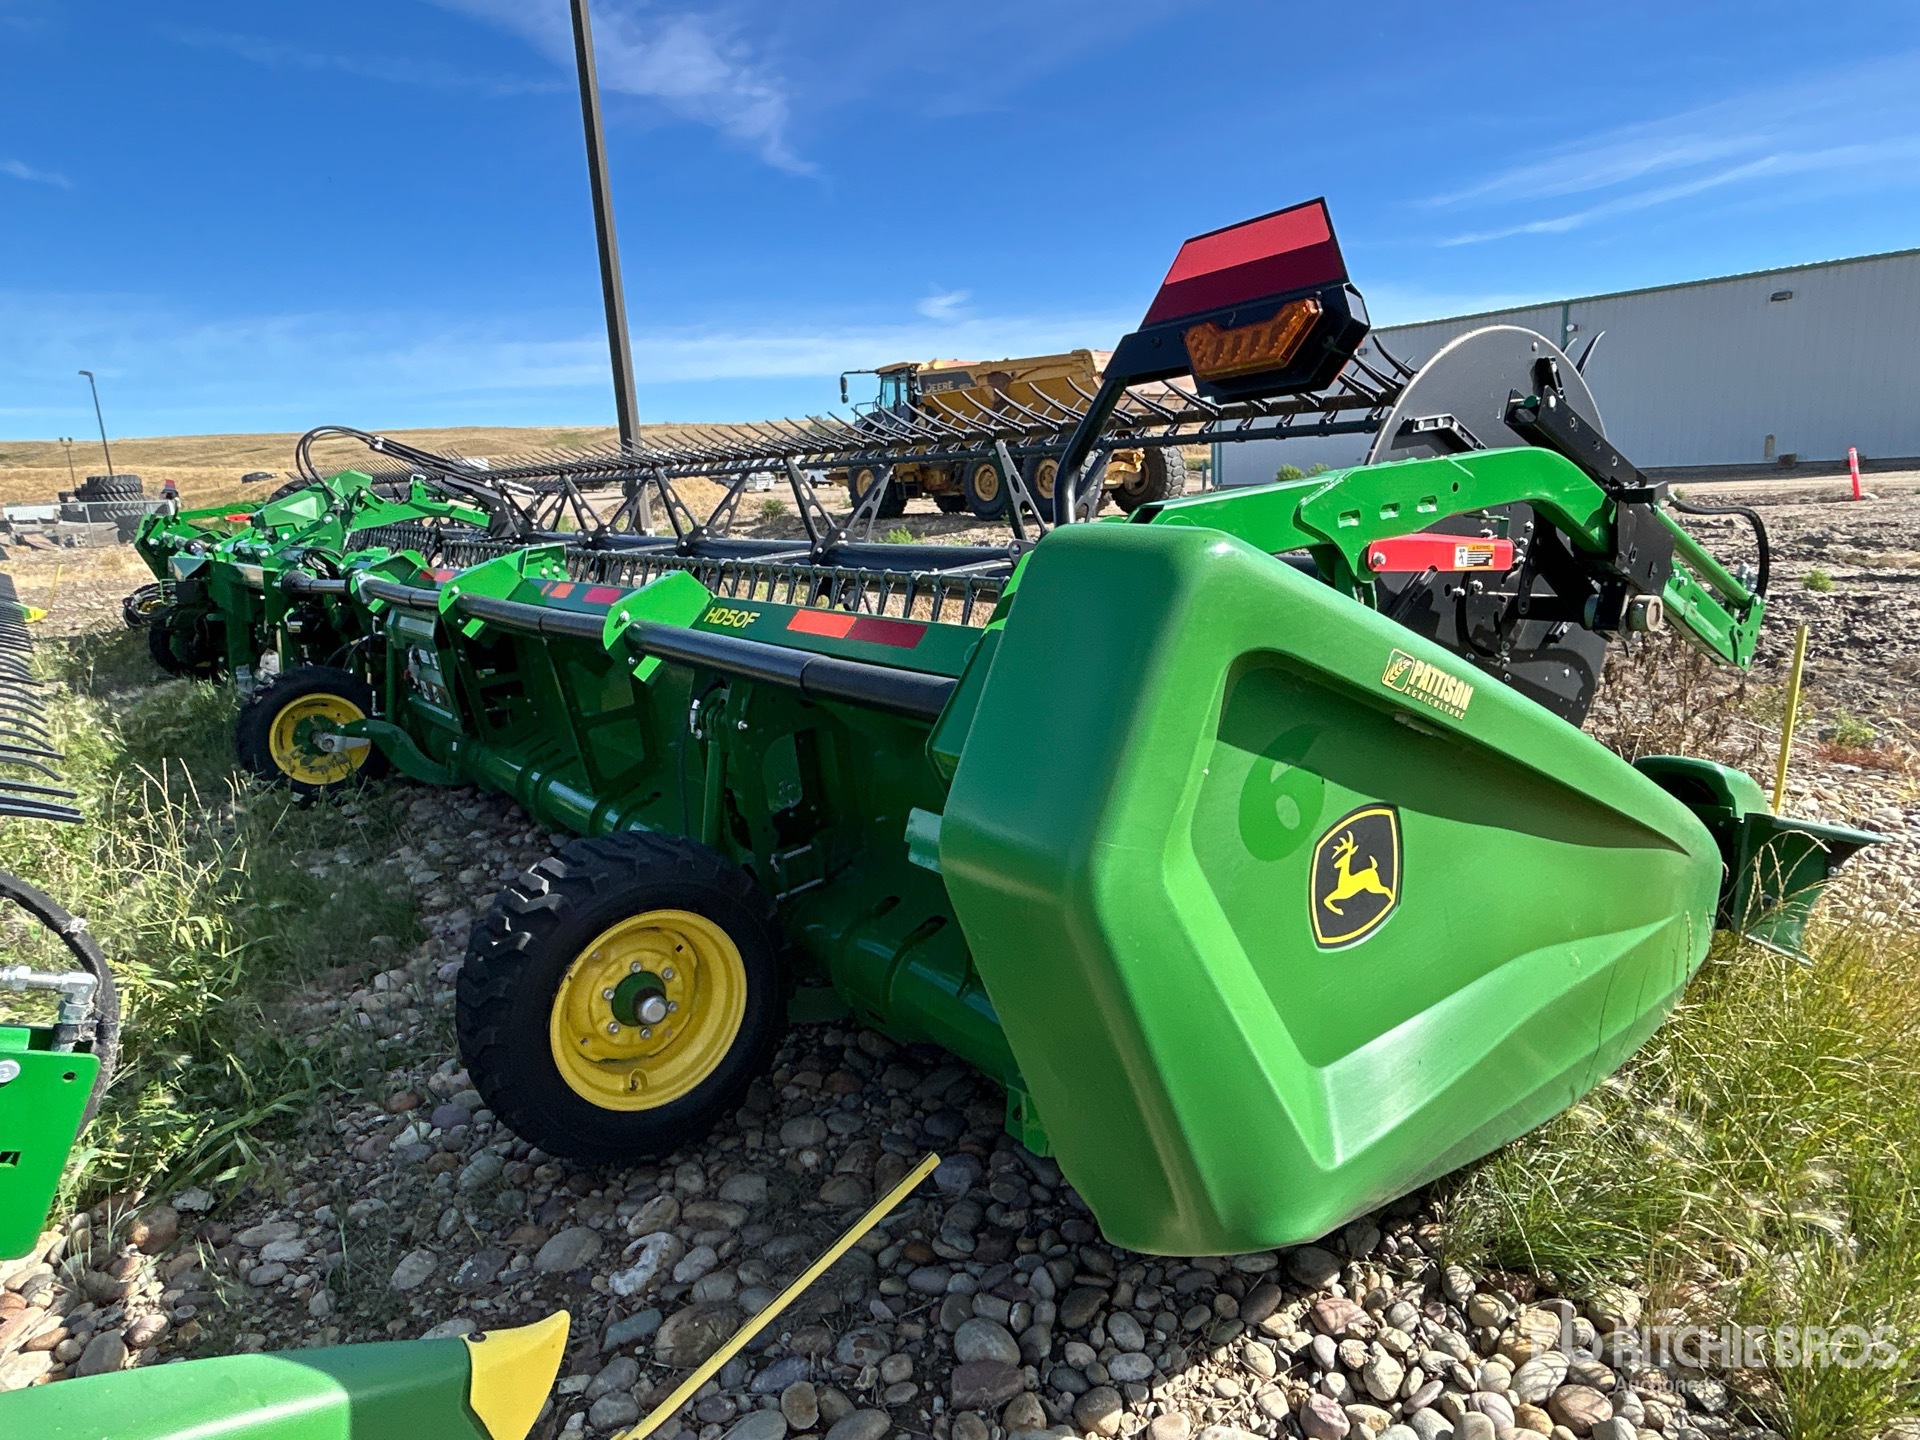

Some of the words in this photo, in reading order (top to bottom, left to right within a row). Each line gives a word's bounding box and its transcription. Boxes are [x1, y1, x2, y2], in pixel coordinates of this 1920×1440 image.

[925, 380, 954, 394] DEERE
[703, 607, 760, 629] HD50F
[1408, 659, 1474, 711] PATTISON
[1404, 686, 1466, 721] AGRICULTURE
[1238, 722, 1326, 862] 6
